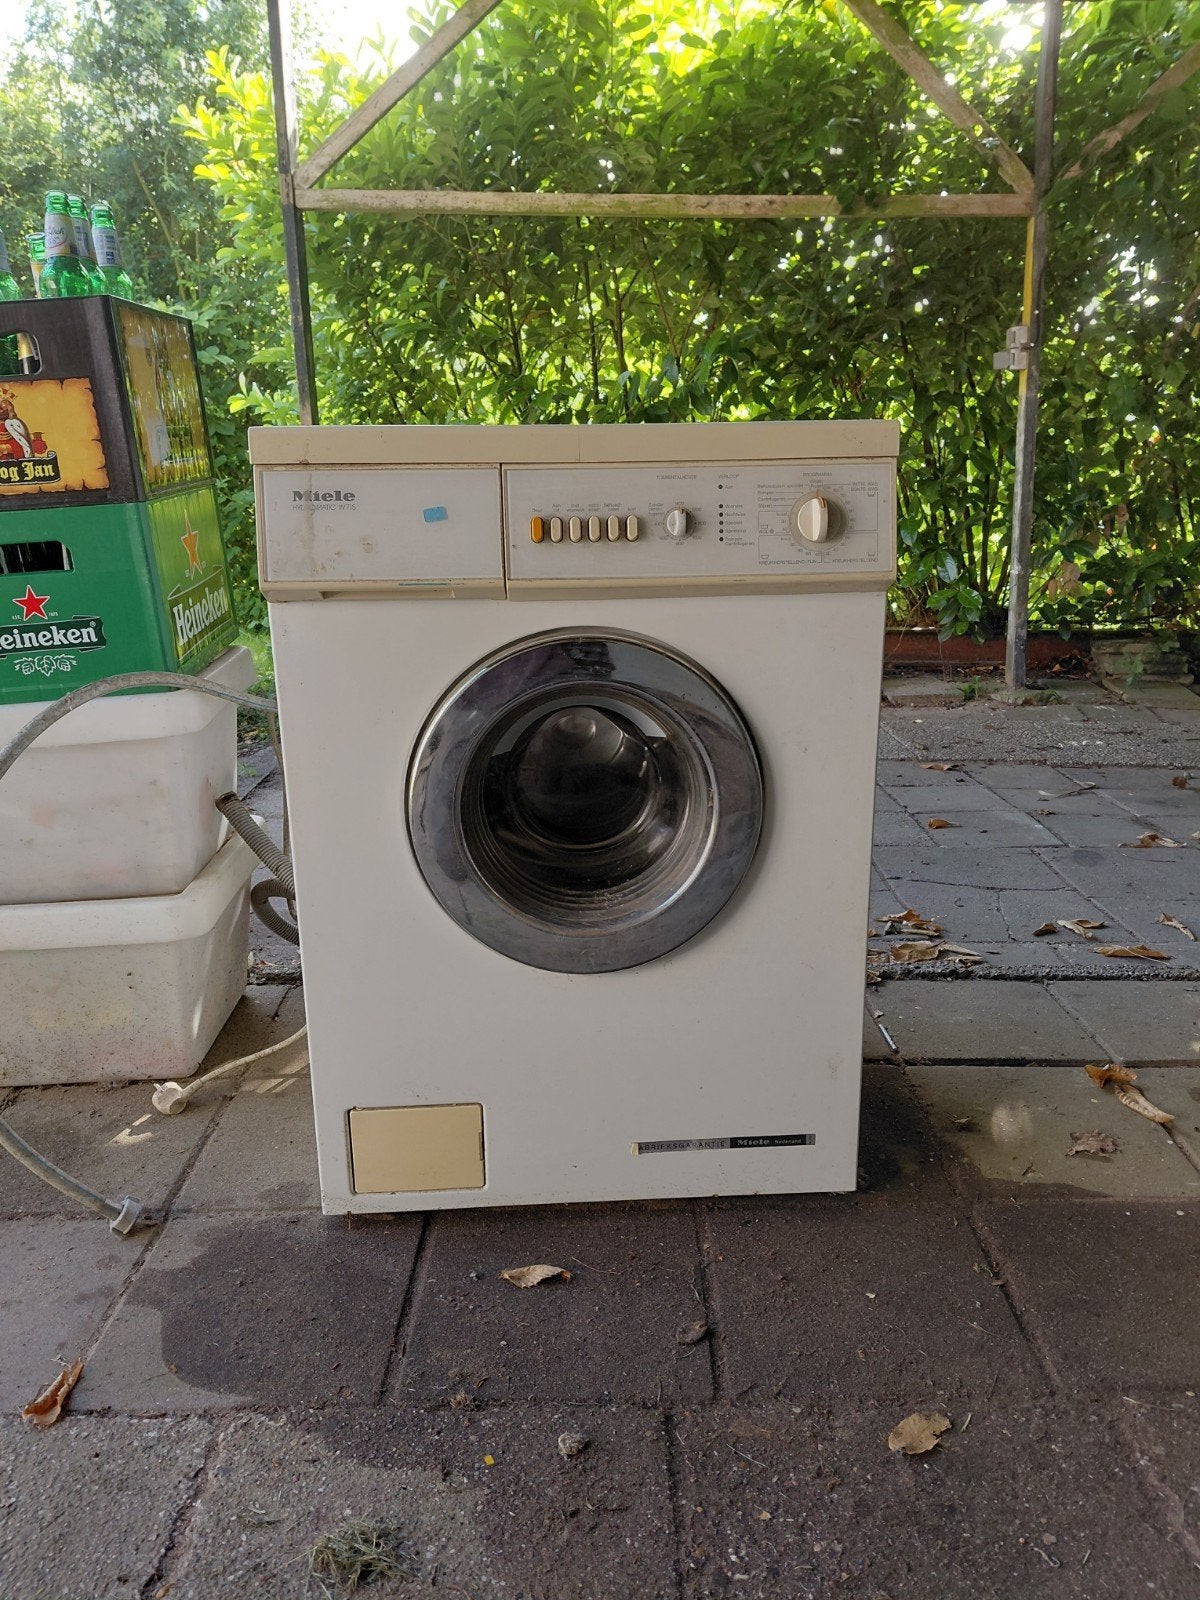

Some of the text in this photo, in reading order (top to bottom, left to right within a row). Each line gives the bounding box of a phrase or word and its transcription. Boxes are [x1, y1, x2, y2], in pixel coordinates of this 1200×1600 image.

[21, 461, 55, 480] Jan
[292, 490, 356, 502] Miele
[172, 586, 229, 647] Heineken
[0, 625, 98, 650] eineken
[638, 1140, 725, 1151] ABRIEKSGARANTIE
[737, 1138, 770, 1146] Miele
